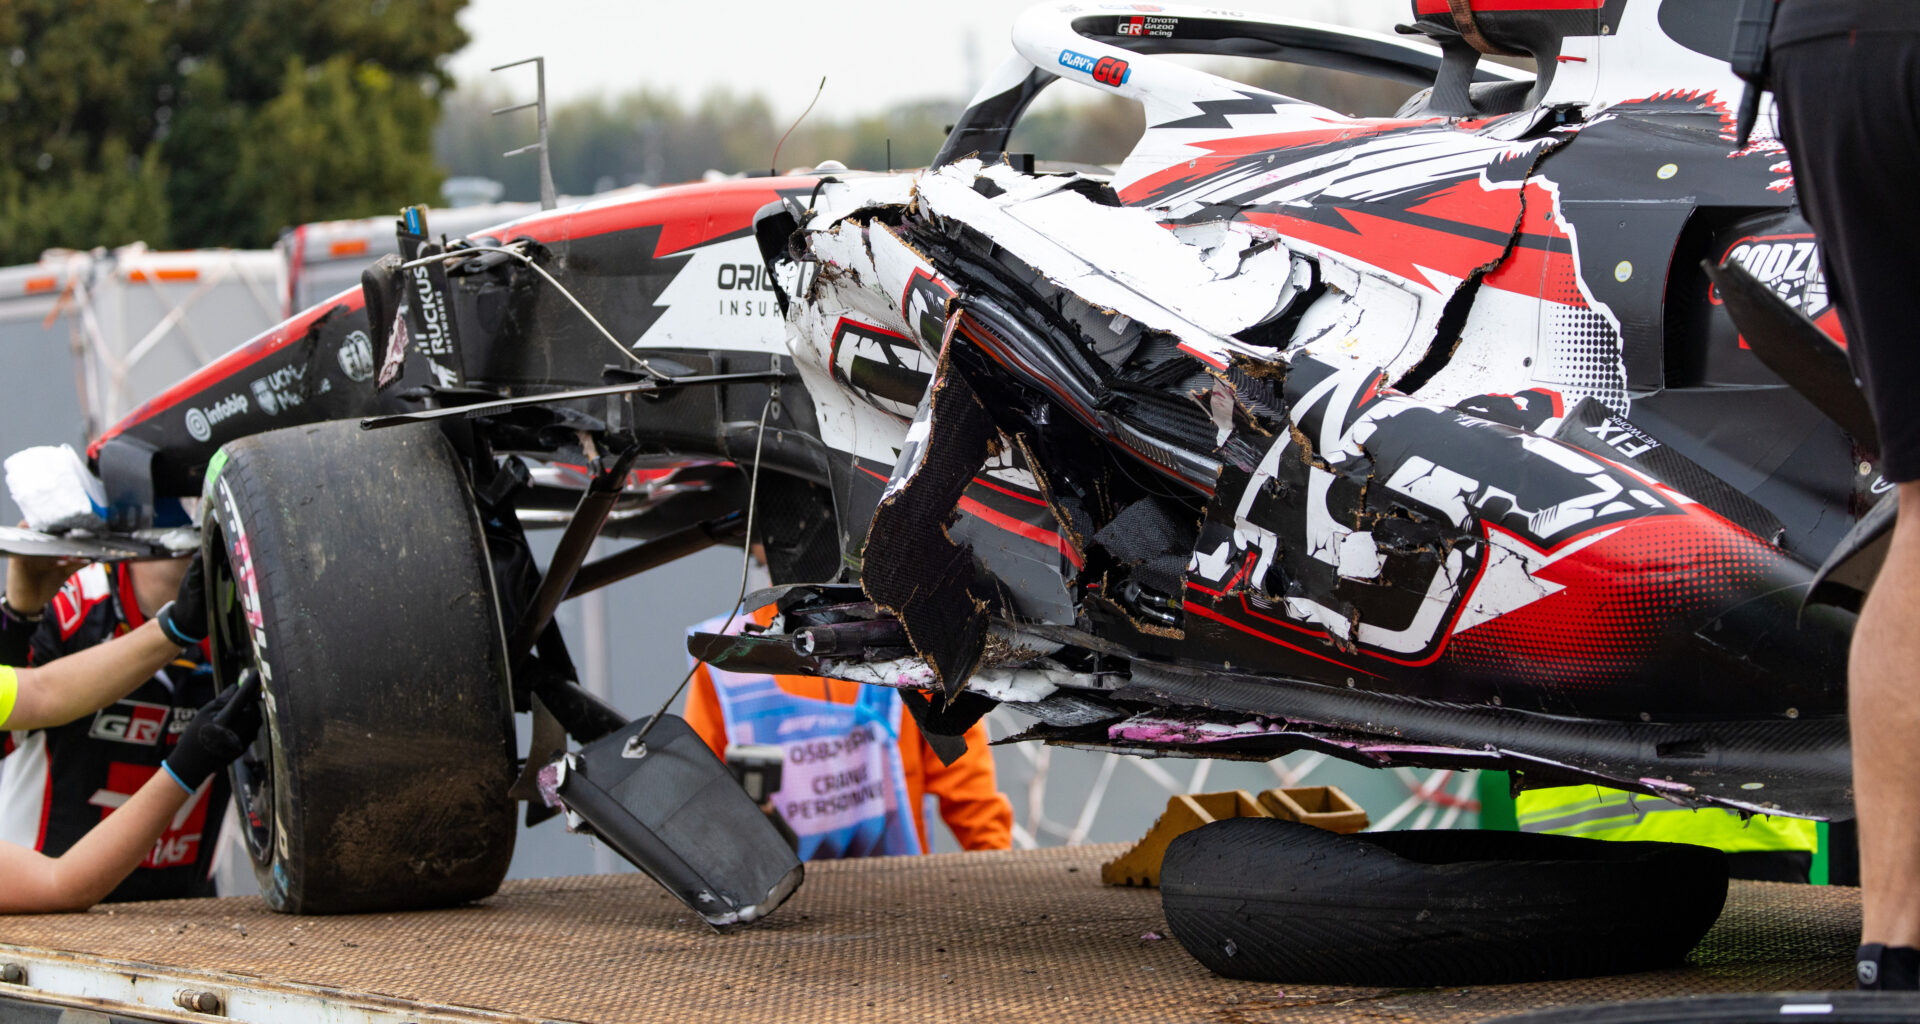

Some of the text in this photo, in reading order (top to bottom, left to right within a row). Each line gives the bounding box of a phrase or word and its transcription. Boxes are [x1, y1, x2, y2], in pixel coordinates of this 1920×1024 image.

[1118, 23, 1142, 35] GR
[1143, 29, 1173, 38] Racing
[1145, 16, 1179, 25] TOYOTA
[1094, 57, 1128, 87] GO
[413, 265, 446, 355] RUCKUS
[434, 290, 453, 354] NETWORKS
[204, 393, 248, 425] infobip
[1584, 418, 1652, 458] FIX
[1608, 414, 1661, 448] NETWORK
[95, 715, 160, 742] GR
